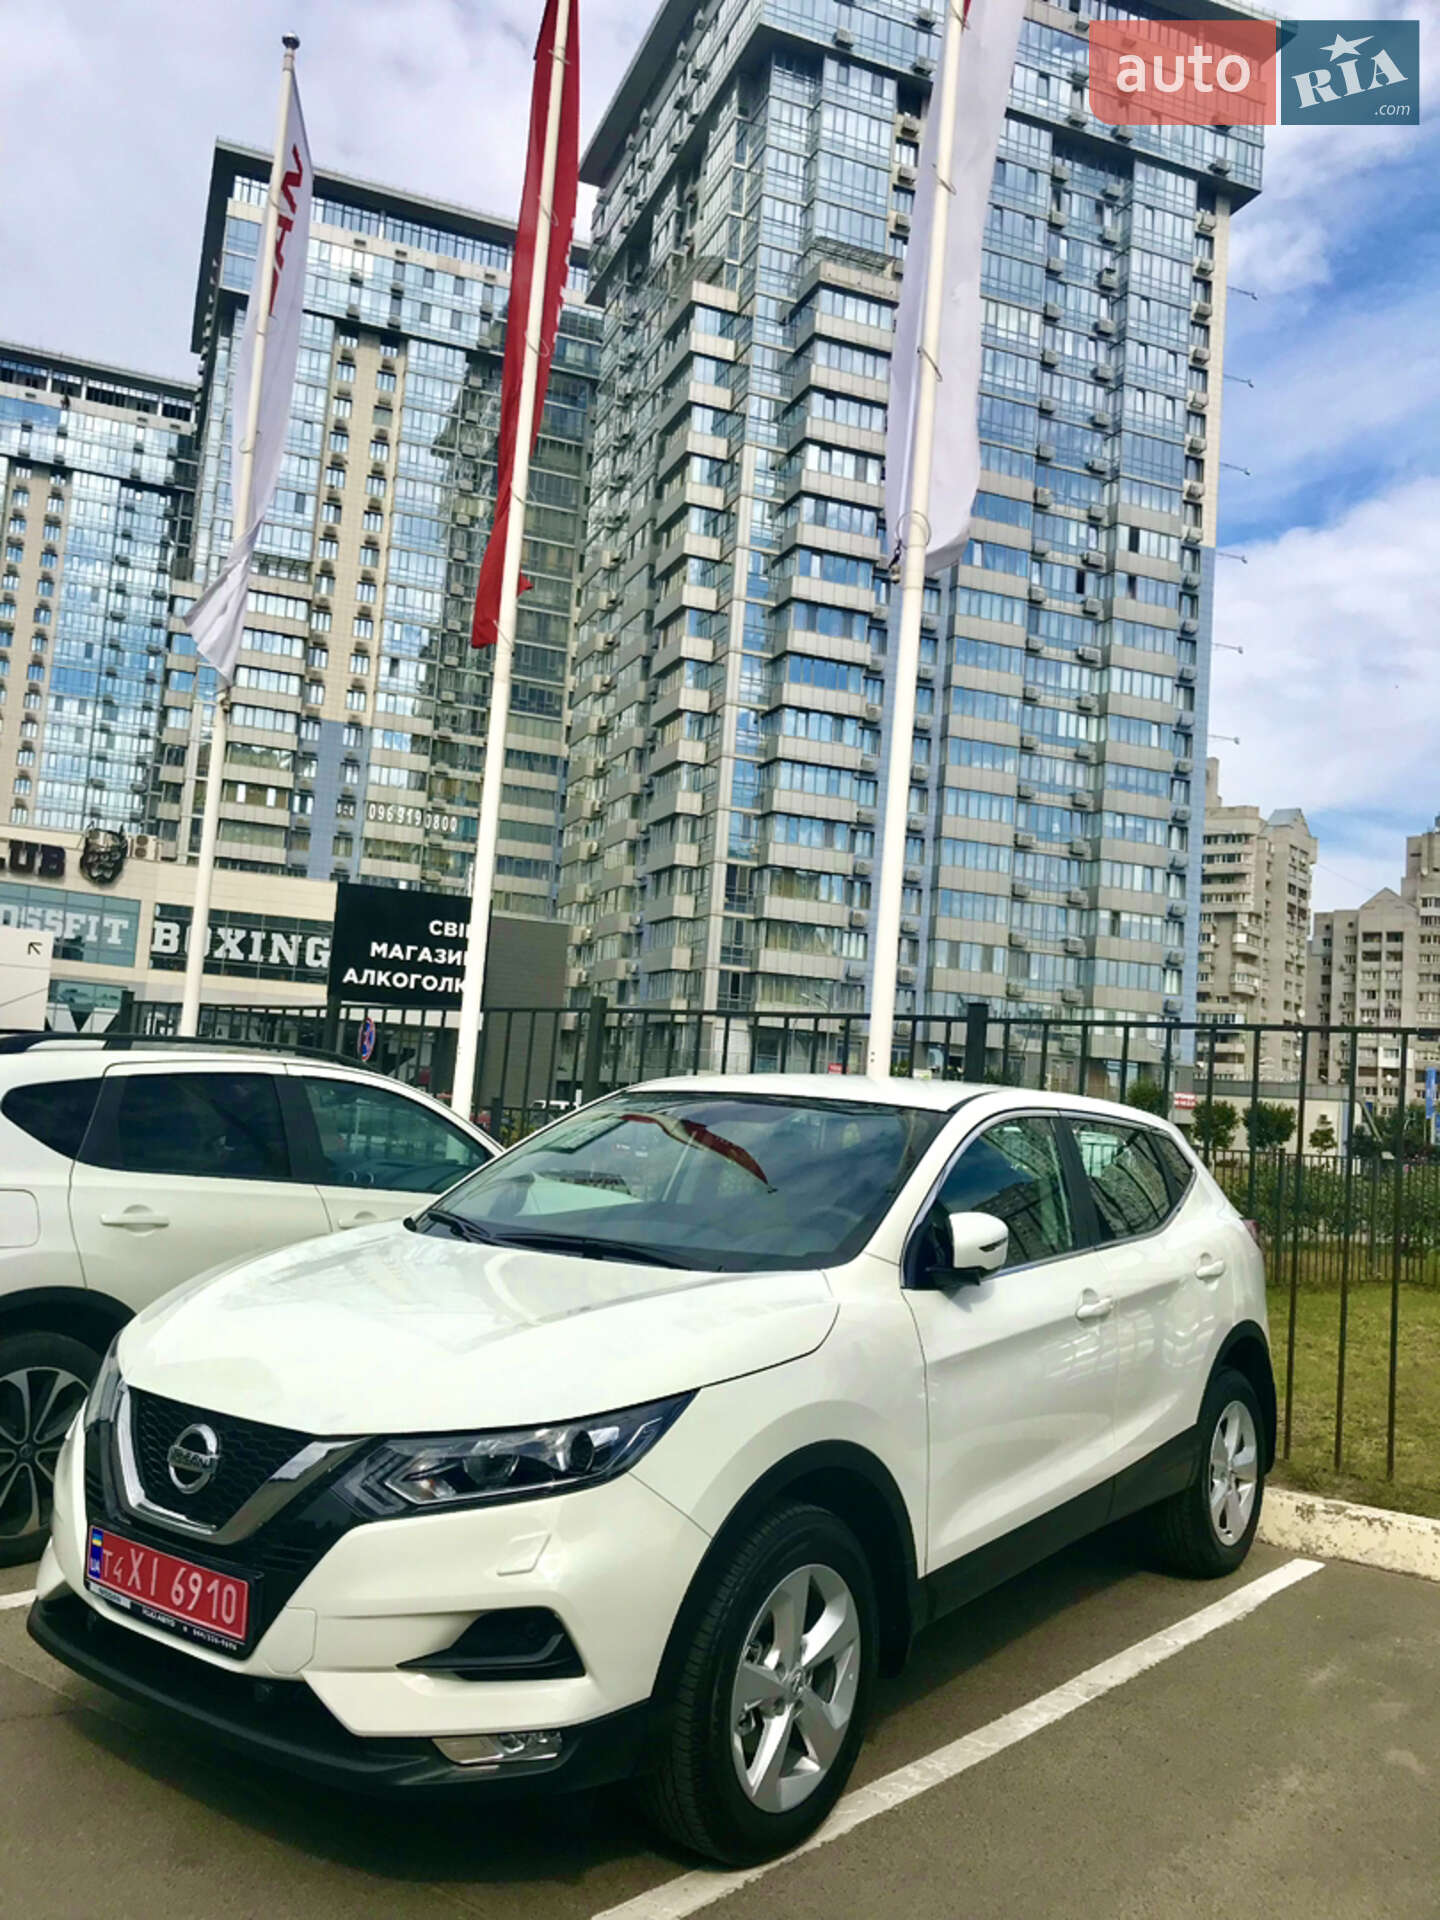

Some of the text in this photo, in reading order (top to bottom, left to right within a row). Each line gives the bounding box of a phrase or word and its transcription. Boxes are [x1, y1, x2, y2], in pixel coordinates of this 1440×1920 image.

[0, 838, 66, 878] UB
[370, 941, 468, 966] МАГАЗИ
[171, 1567, 238, 1624] 6910
